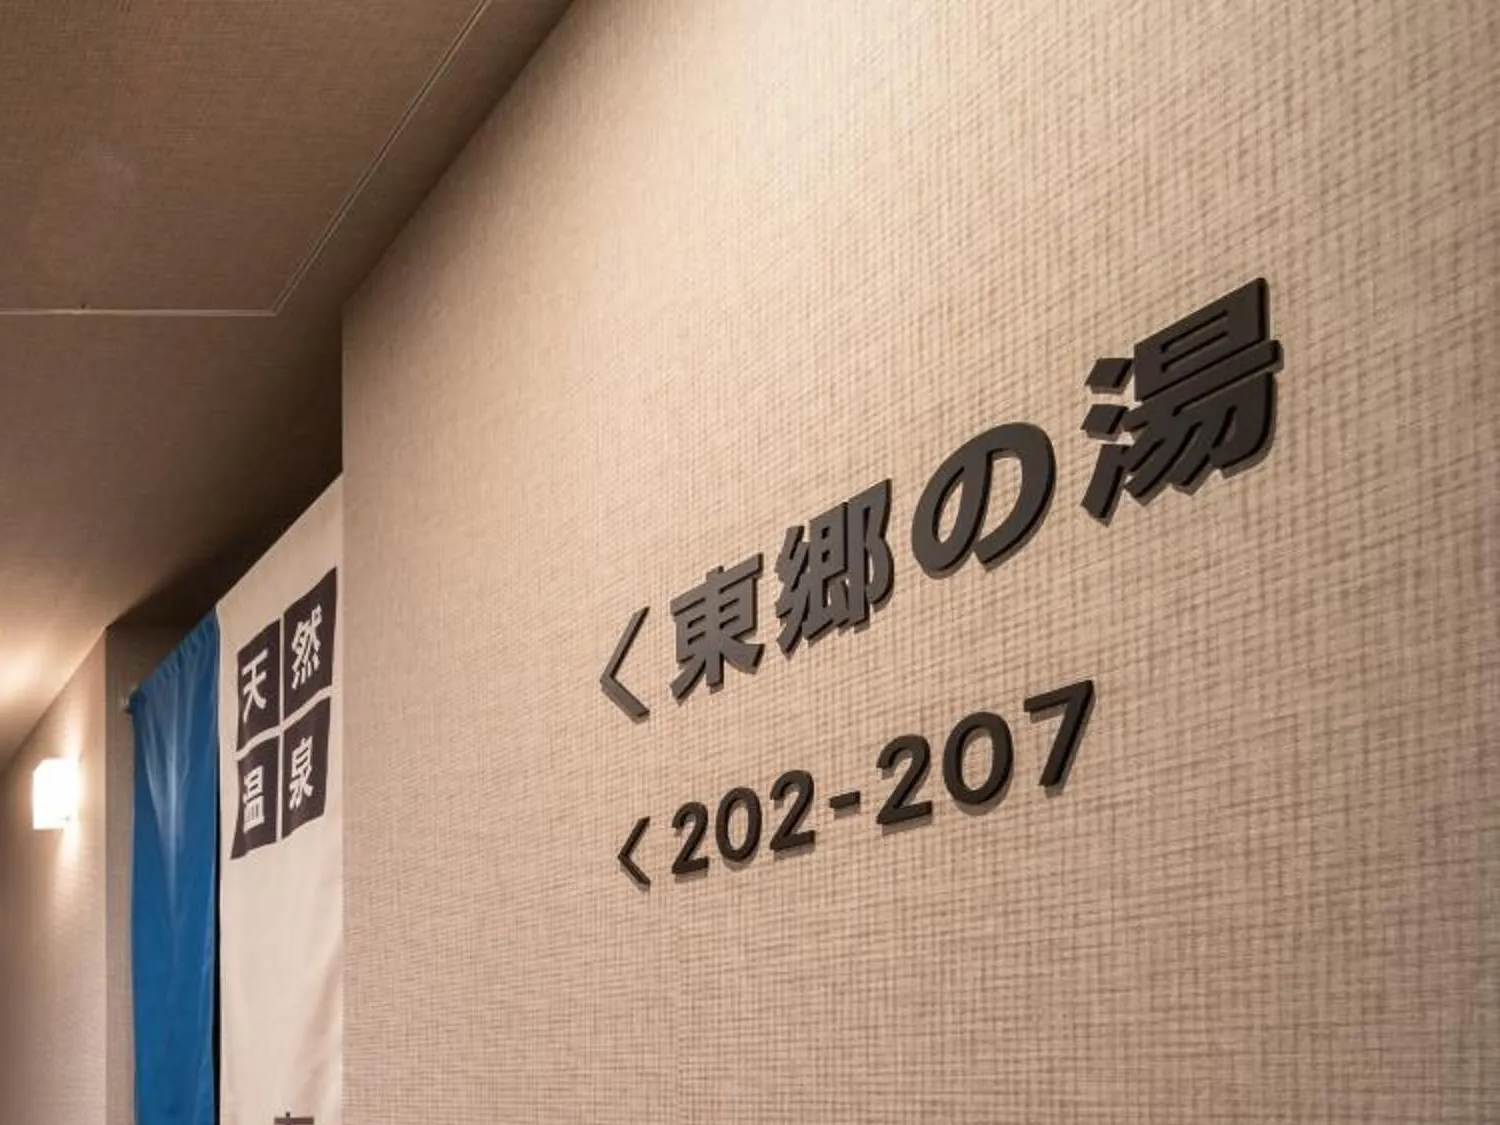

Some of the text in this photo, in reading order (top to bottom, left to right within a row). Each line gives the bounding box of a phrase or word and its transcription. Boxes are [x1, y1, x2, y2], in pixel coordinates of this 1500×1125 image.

[669, 277, 1283, 700] 東郷の湯
[241, 603, 323, 724] 天然
[671, 679, 1096, 875] 202-207
